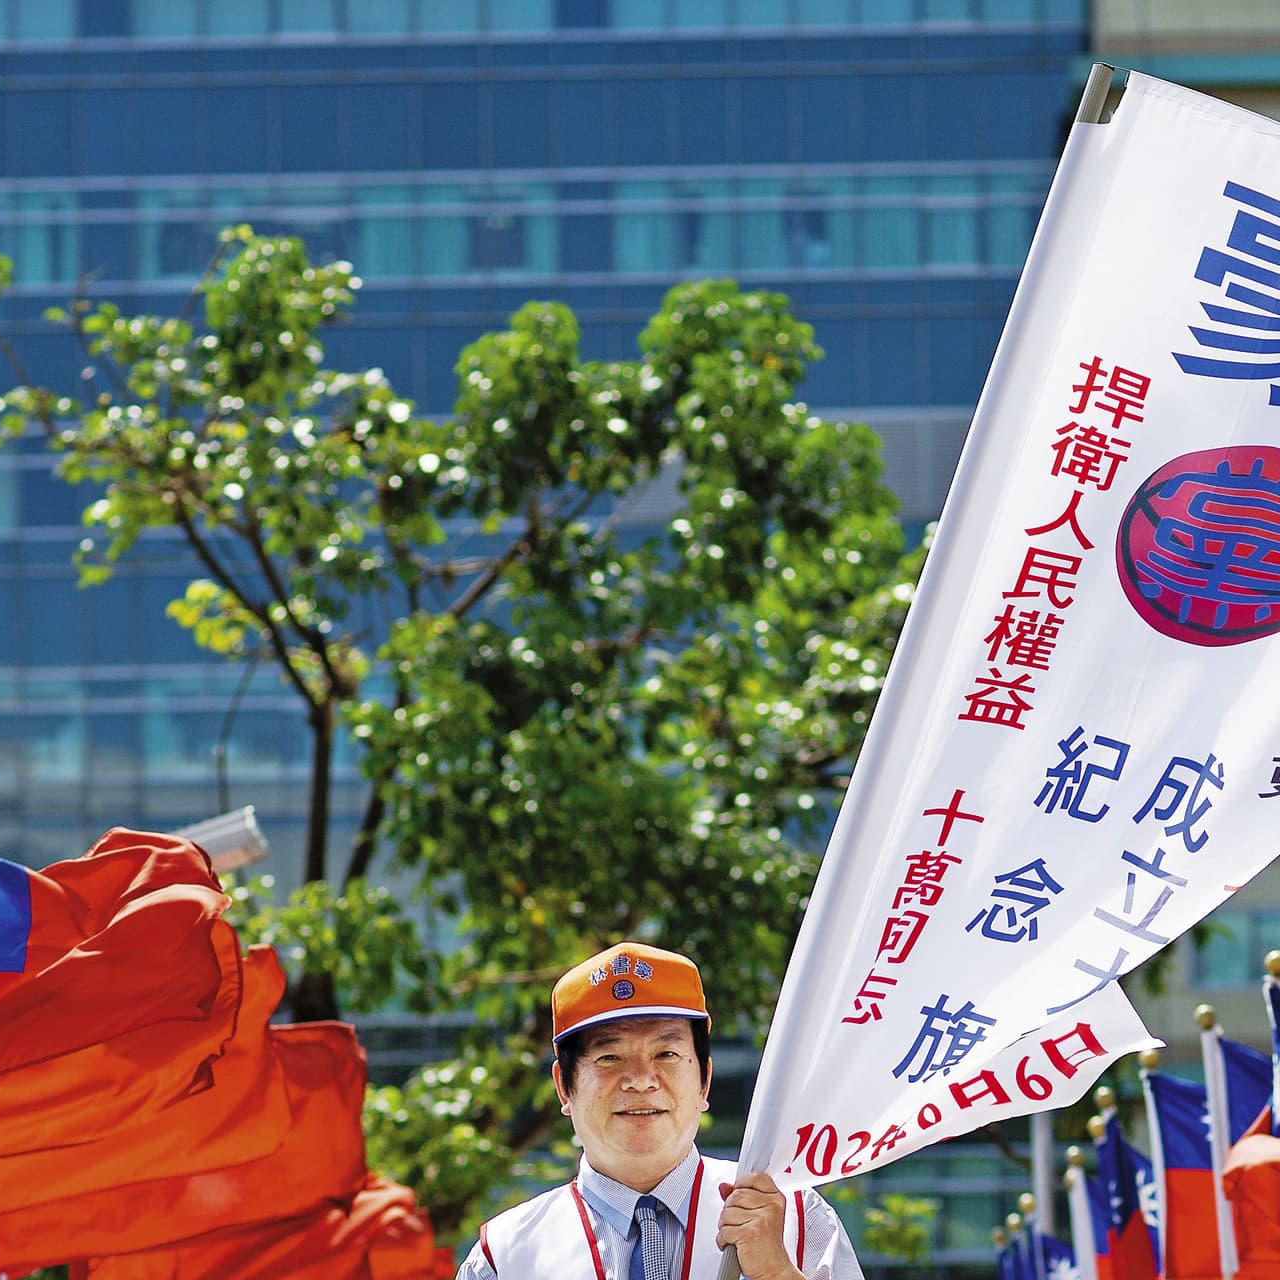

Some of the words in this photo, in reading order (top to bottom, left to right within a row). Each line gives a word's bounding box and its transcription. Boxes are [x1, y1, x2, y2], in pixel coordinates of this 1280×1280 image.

[957, 355, 1153, 731] 捍衛人民權益
